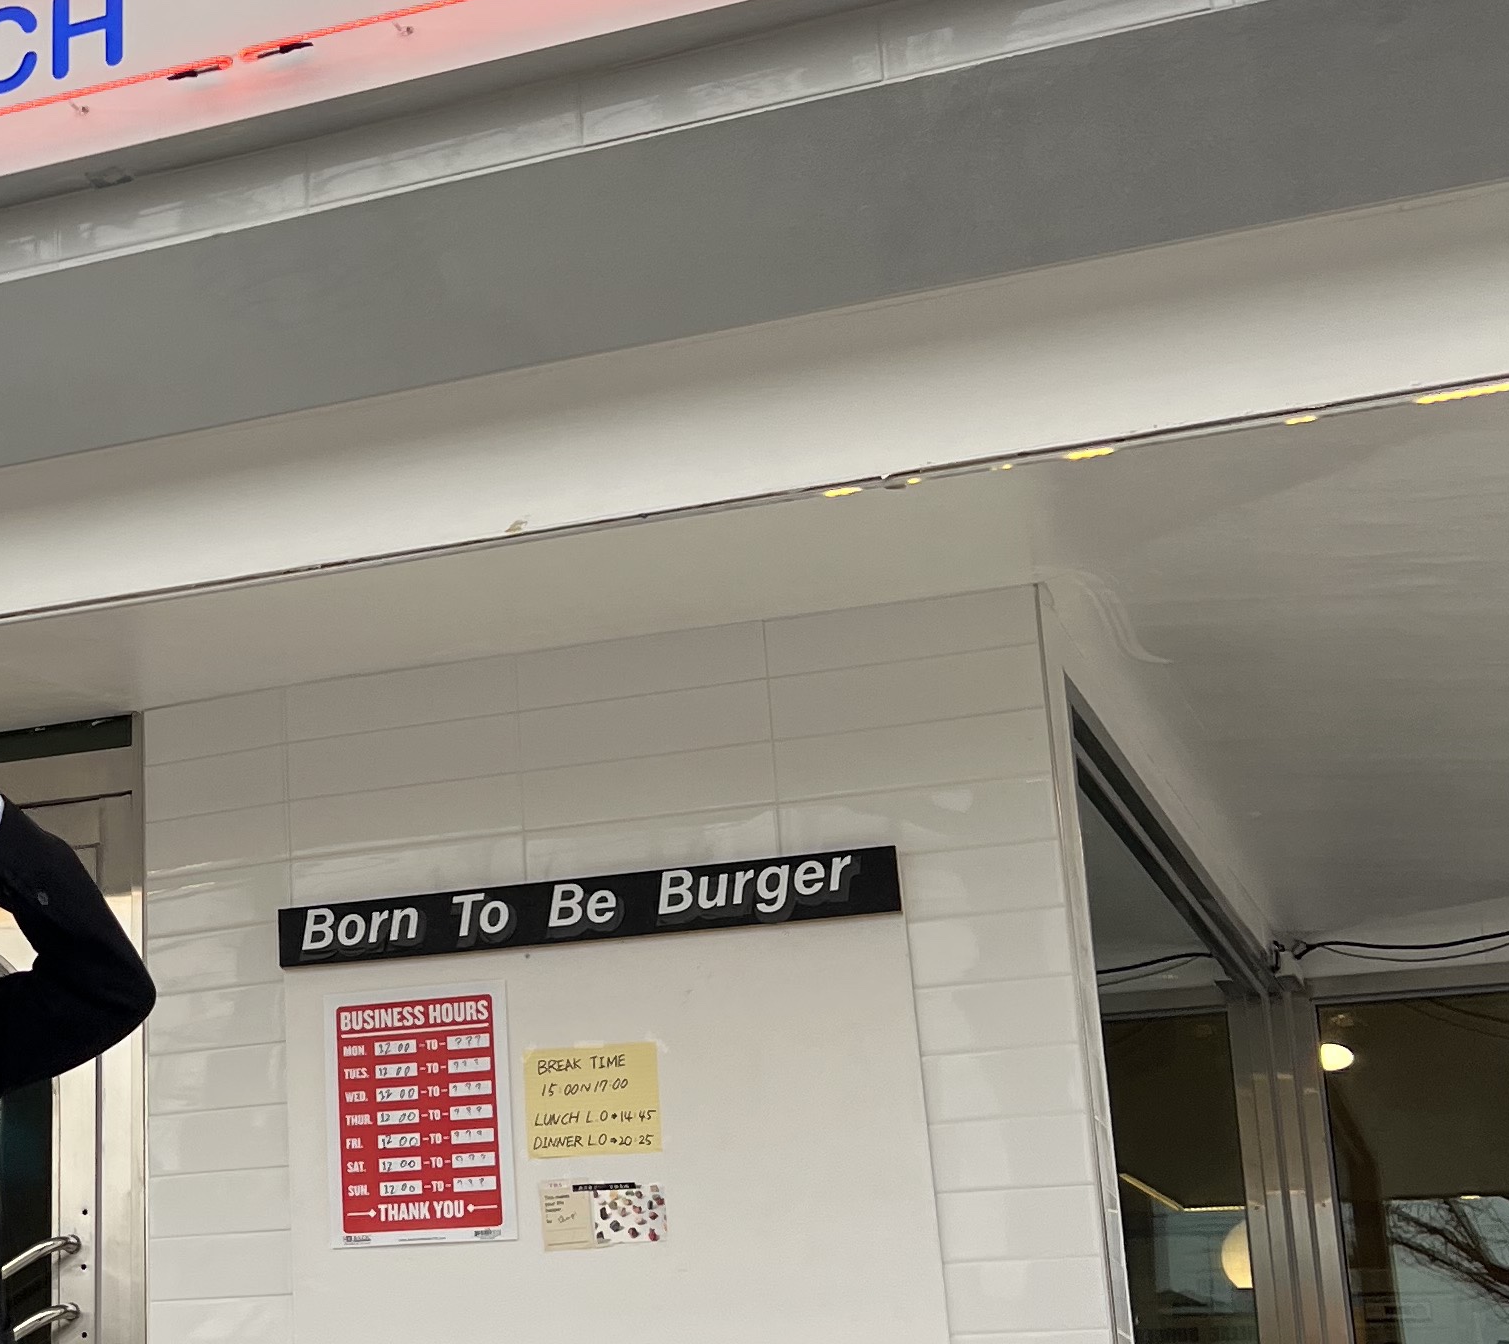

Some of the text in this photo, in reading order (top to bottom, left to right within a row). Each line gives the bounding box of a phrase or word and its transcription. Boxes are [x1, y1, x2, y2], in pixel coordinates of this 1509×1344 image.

[301, 855, 852, 952] Born To Be Burger
[339, 999, 489, 1032] BUSINESS HOURS
[537, 1053, 626, 1075] BREAK TIME
[534, 1110, 581, 1126] LUNCH
[533, 1135, 584, 1151] DINNER
[378, 1199, 465, 1222] THANK YOU
